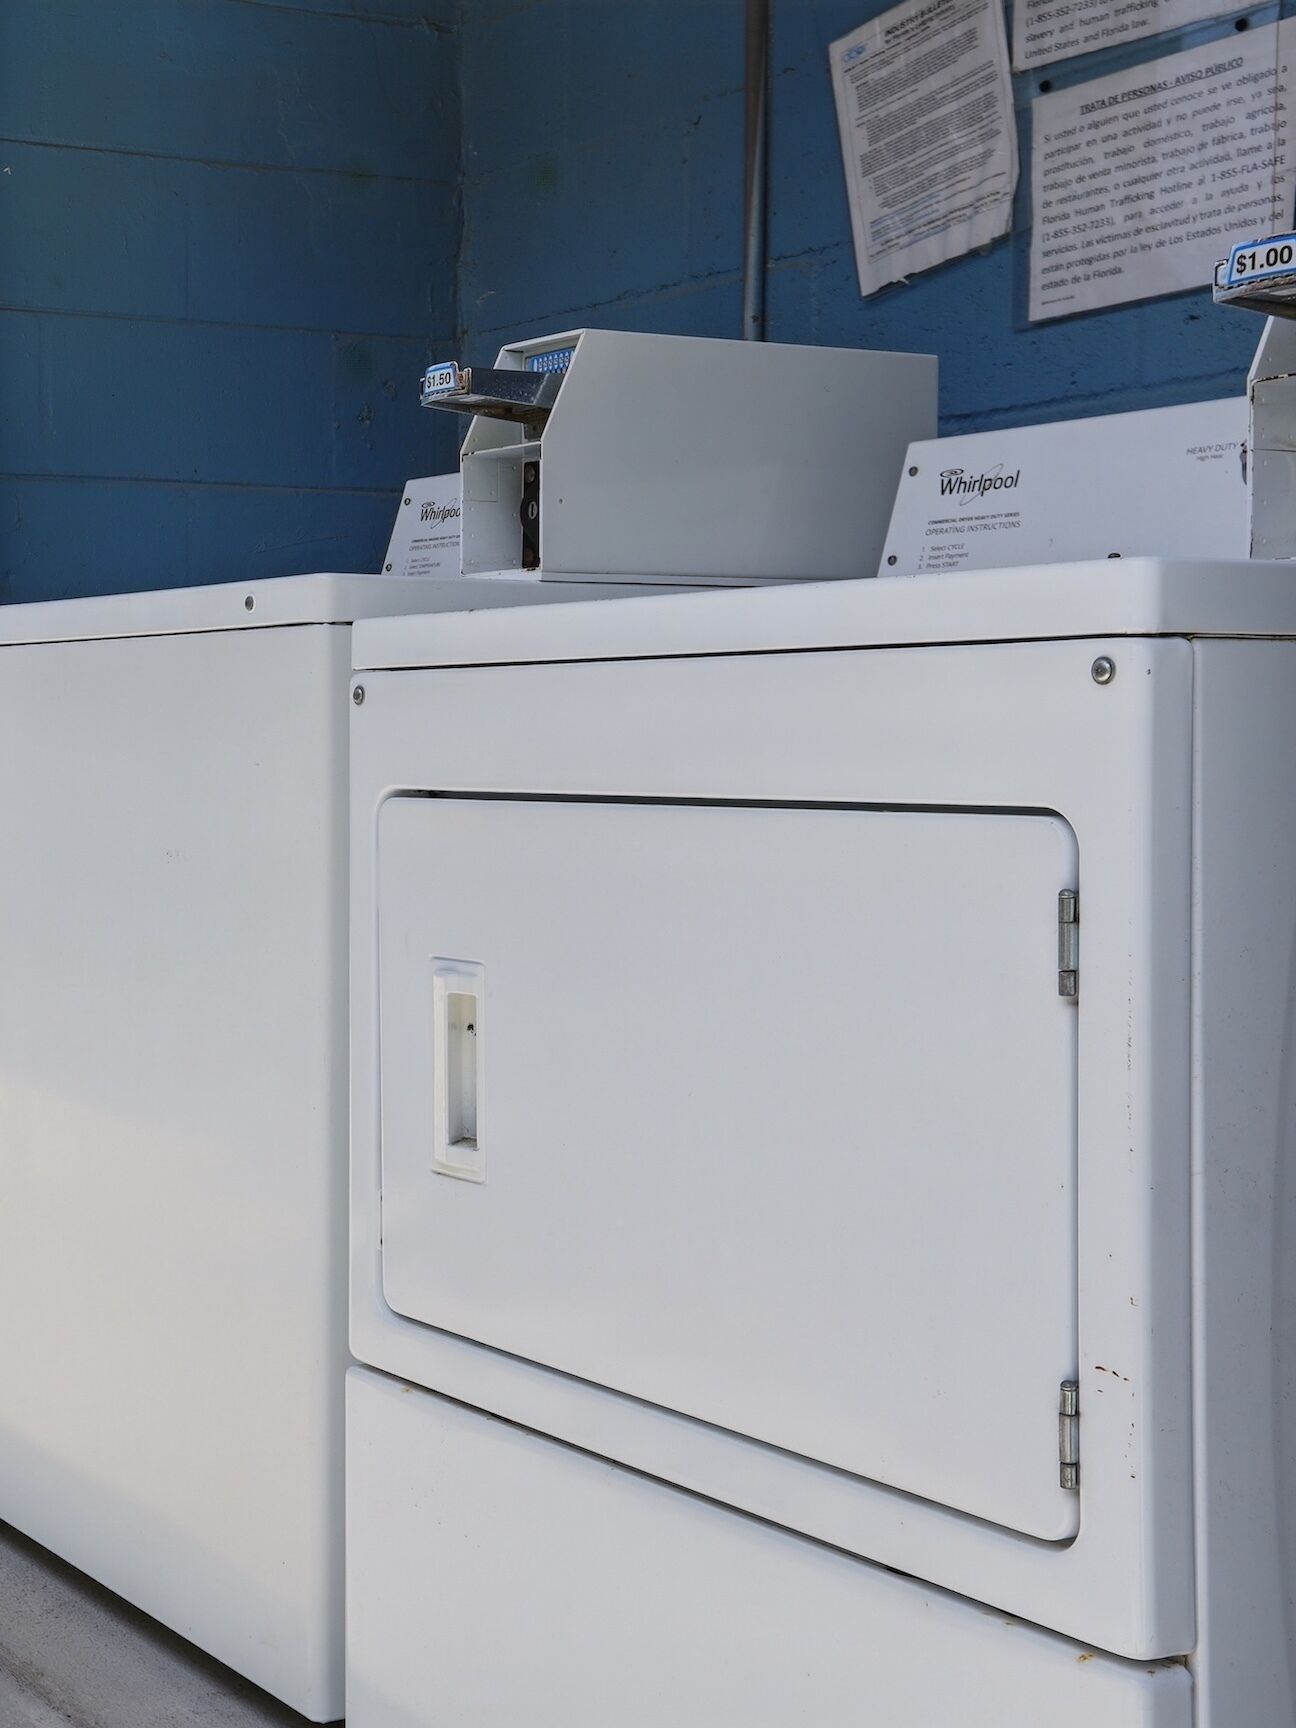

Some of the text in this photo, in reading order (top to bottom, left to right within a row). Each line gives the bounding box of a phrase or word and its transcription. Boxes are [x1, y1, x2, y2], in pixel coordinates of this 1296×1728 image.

[1025, 0, 1159, 43] slavery and human trafficking
[1025, 46, 1053, 59] United
[1054, 40, 1080, 51] States
[1083, 31, 1100, 43] and
[1101, 24, 1129, 38] Florida
[1054, 127, 1077, 140] usted
[1087, 115, 1119, 130] alguien
[1122, 110, 1140, 121] que
[1143, 99, 1168, 114] usted
[1170, 91, 1204, 106] conoce
[1207, 87, 1218, 95] se
[1221, 82, 1232, 91] ve
[1236, 67, 1277, 86] obligado
[1281, 65, 1287, 73] a
[1079, 99, 1105, 115] TRATA
[1108, 94, 1120, 106] DE
[1121, 80, 1168, 100] PERSONAS
[1175, 70, 1203, 87] AVISO
[1044, 143, 1082, 160] participar
[1085, 139, 1097, 147] en
[1101, 133, 1118, 143] una
[1122, 120, 1162, 137] actividad
[1176, 113, 1187, 121] no
[1192, 103, 1221, 117] puede
[1251, 91, 1262, 102] ya
[1104, 145, 1135, 160] trabajo
[1202, 116, 1235, 132] trabajo
[1042, 179, 1073, 192] trabajo
[1075, 175, 1086, 184] de
[1088, 168, 1111, 180] venta
[1161, 146, 1195, 160] trabajo
[1197, 141, 1208, 151] de
[1250, 120, 1287, 136] trabajo
[1042, 200, 1053, 209] de
[1122, 172, 1163, 188] cualquier
[1166, 165, 1184, 176] otra
[1236, 144, 1263, 157] llame
[1266, 142, 1273, 150] a
[1042, 155, 1286, 225] Florida Human Trafficking Hotline al 1-855-FLA-SAFE
[1123, 211, 1143, 223] para
[1149, 200, 1183, 215] acceder
[1191, 197, 1197, 205] a
[1205, 192, 1214, 201] la
[1220, 183, 1249, 198] ayuda
[1256, 181, 1262, 191] y
[1065, 252, 1111, 271] protegidas
[1112, 248, 1127, 260] por
[1129, 244, 1138, 254] la
[1139, 242, 1153, 253] ley
[1155, 238, 1167, 248] de
[1169, 236, 1184, 245] Los
[1186, 226, 1222, 241] Estados
[1224, 218, 1257, 232] Unidos
[1259, 216, 1266, 225] y
[1268, 209, 1284, 222] del
[1081, 240, 1094, 249] Las
[1132, 227, 1144, 236] de
[1145, 213, 1190, 234] esclavitud
[1191, 215, 1198, 224] y
[1199, 209, 1222, 220] trata
[1224, 204, 1235, 214] de
[1041, 266, 1124, 291] estado de la Florida.
[1236, 245, 1293, 275] $1.00
[427, 372, 451, 389] $1.50
[1186, 441, 1239, 456] HEAVY DUTY
[940, 469, 1021, 497] Whirlpool
[420, 505, 461, 523] Whirlpoo
[925, 520, 1021, 536] OPERATING INSTRUCTIONS
